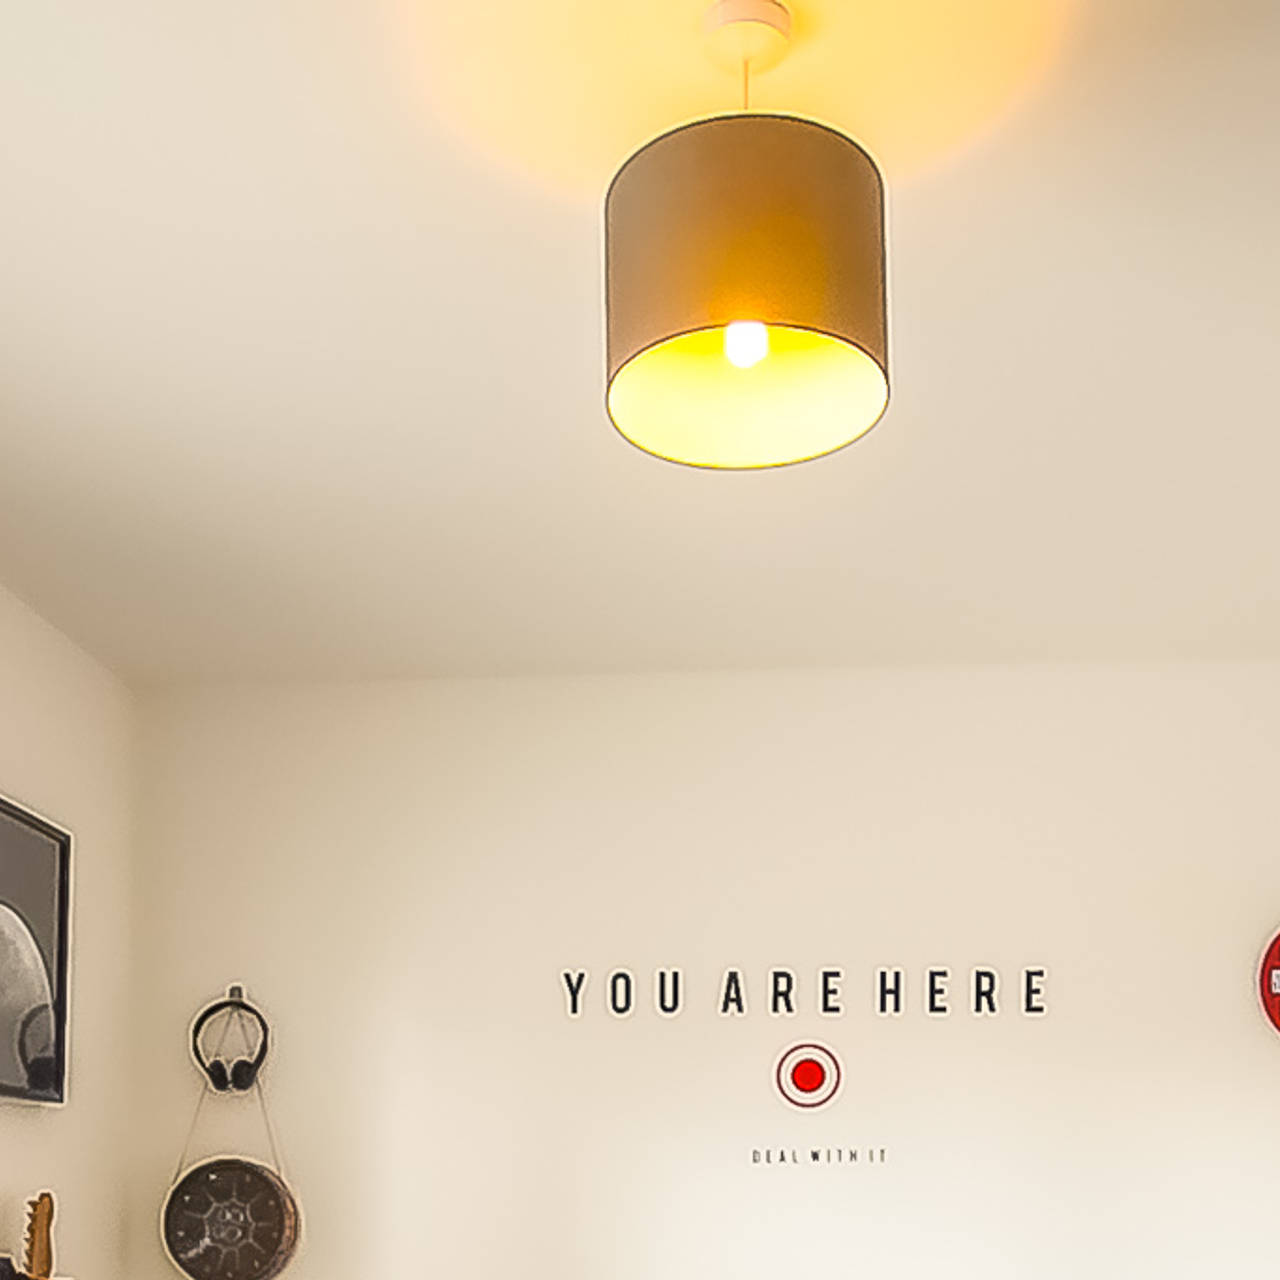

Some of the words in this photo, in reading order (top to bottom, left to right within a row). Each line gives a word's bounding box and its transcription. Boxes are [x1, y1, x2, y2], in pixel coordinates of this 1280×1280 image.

[564, 970, 679, 1014] YOU
[721, 970, 841, 1013] ARE
[879, 969, 1045, 1013] HERE
[752, 1149, 798, 1163] DEAL
[811, 1149, 857, 1163] WITH
[870, 1149, 885, 1163] IT
